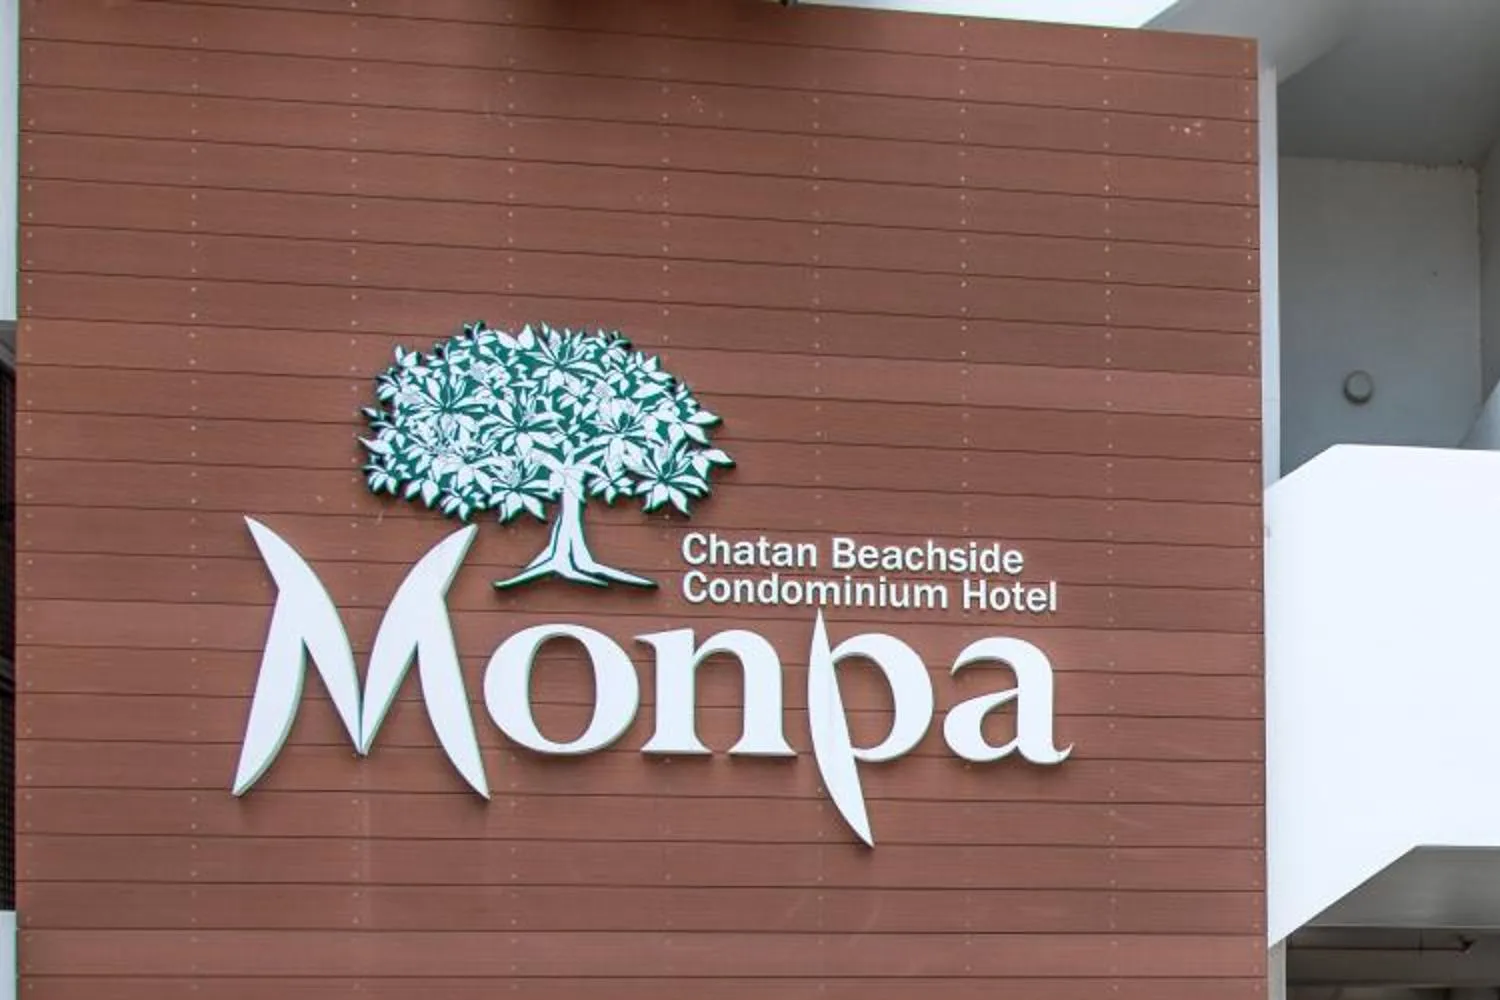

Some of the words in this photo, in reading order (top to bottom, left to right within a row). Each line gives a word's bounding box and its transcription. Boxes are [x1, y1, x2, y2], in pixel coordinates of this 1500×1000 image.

[681, 531, 818, 568] Chatan
[830, 536, 1025, 574] Beachside
[681, 570, 949, 610] Condominium
[962, 578, 1058, 613] Hotel
[232, 515, 1074, 848] Monpa
